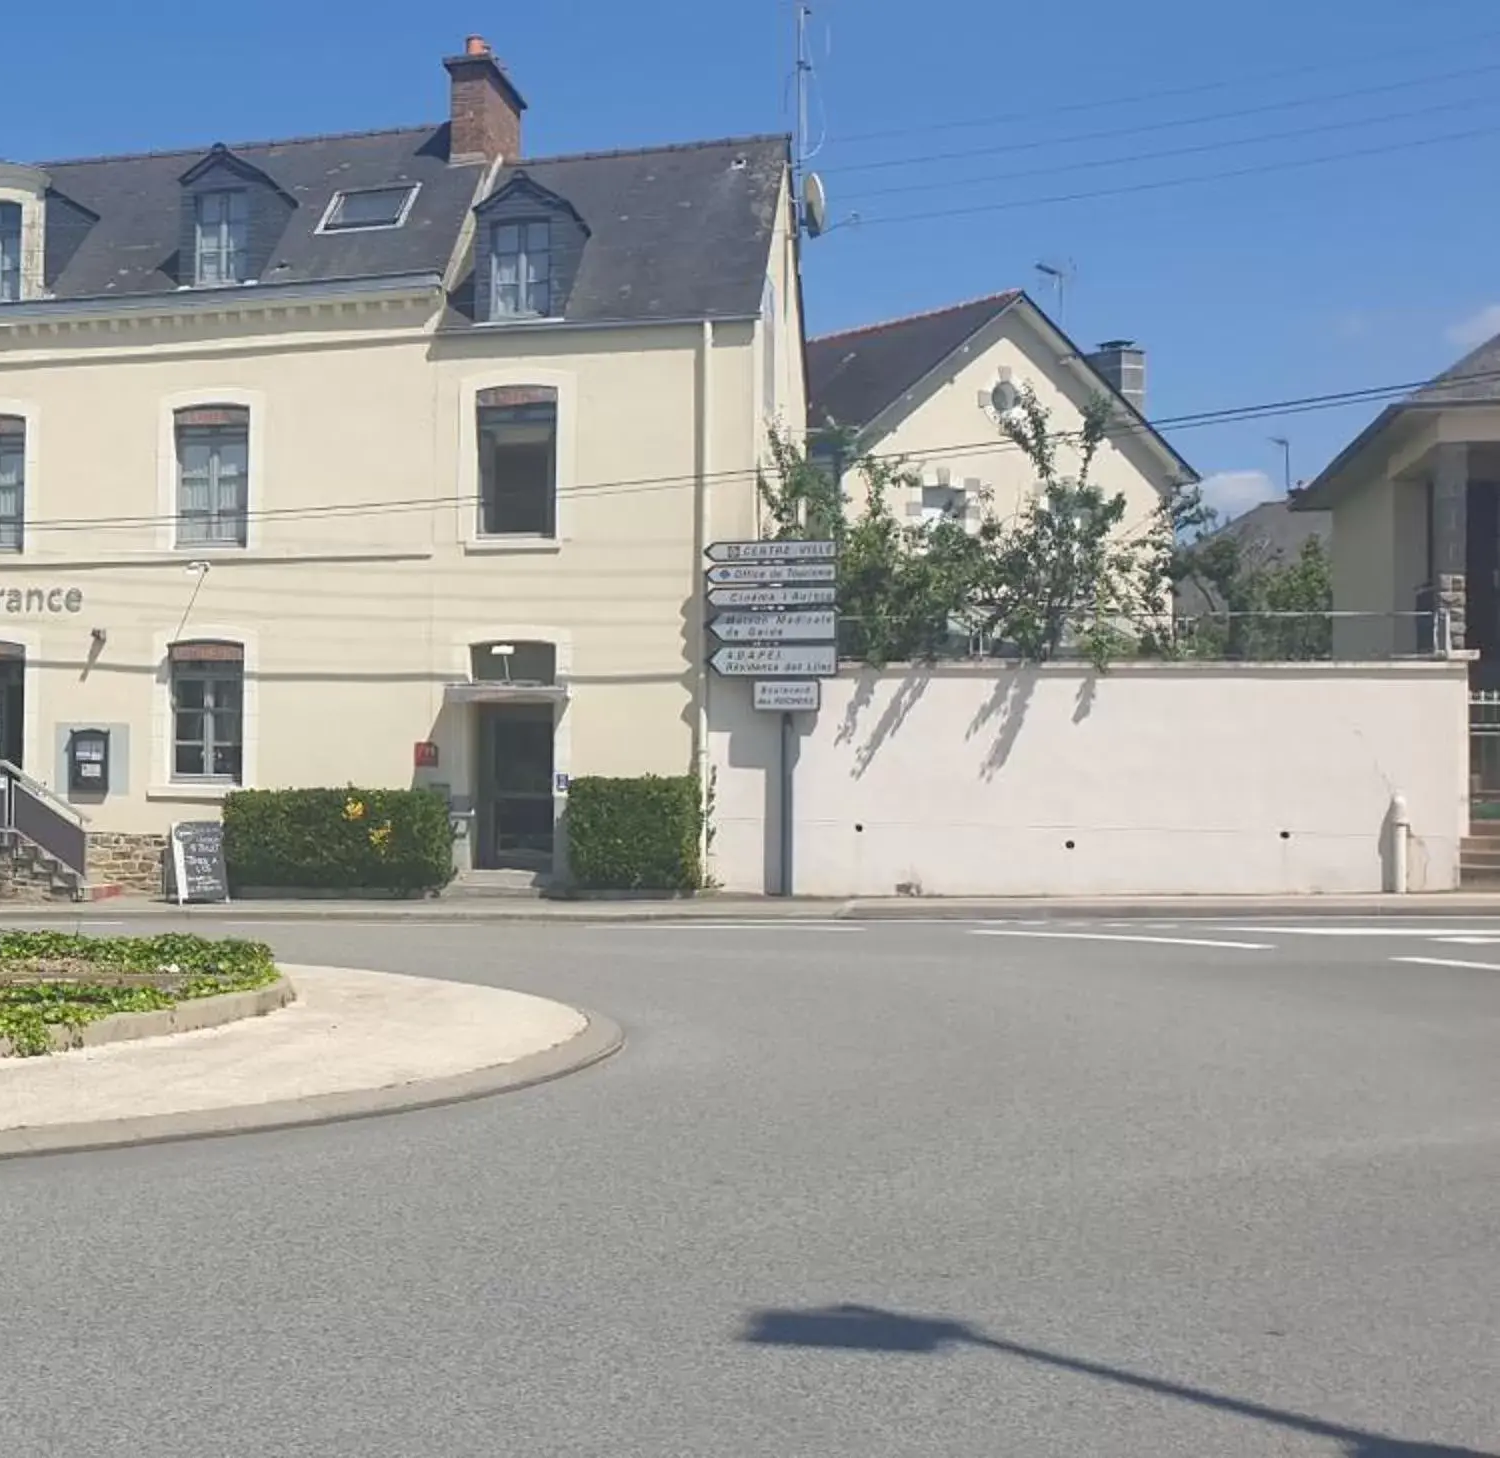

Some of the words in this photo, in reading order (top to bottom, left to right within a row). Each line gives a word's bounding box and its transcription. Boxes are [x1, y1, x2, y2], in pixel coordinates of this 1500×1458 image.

[743, 545, 789, 556] CENTRE
[798, 543, 833, 554] VILLE
[733, 569, 766, 579] Office
[770, 568, 782, 578] de
[787, 568, 833, 579] Tourisme
[729, 592, 775, 603] Cinéma
